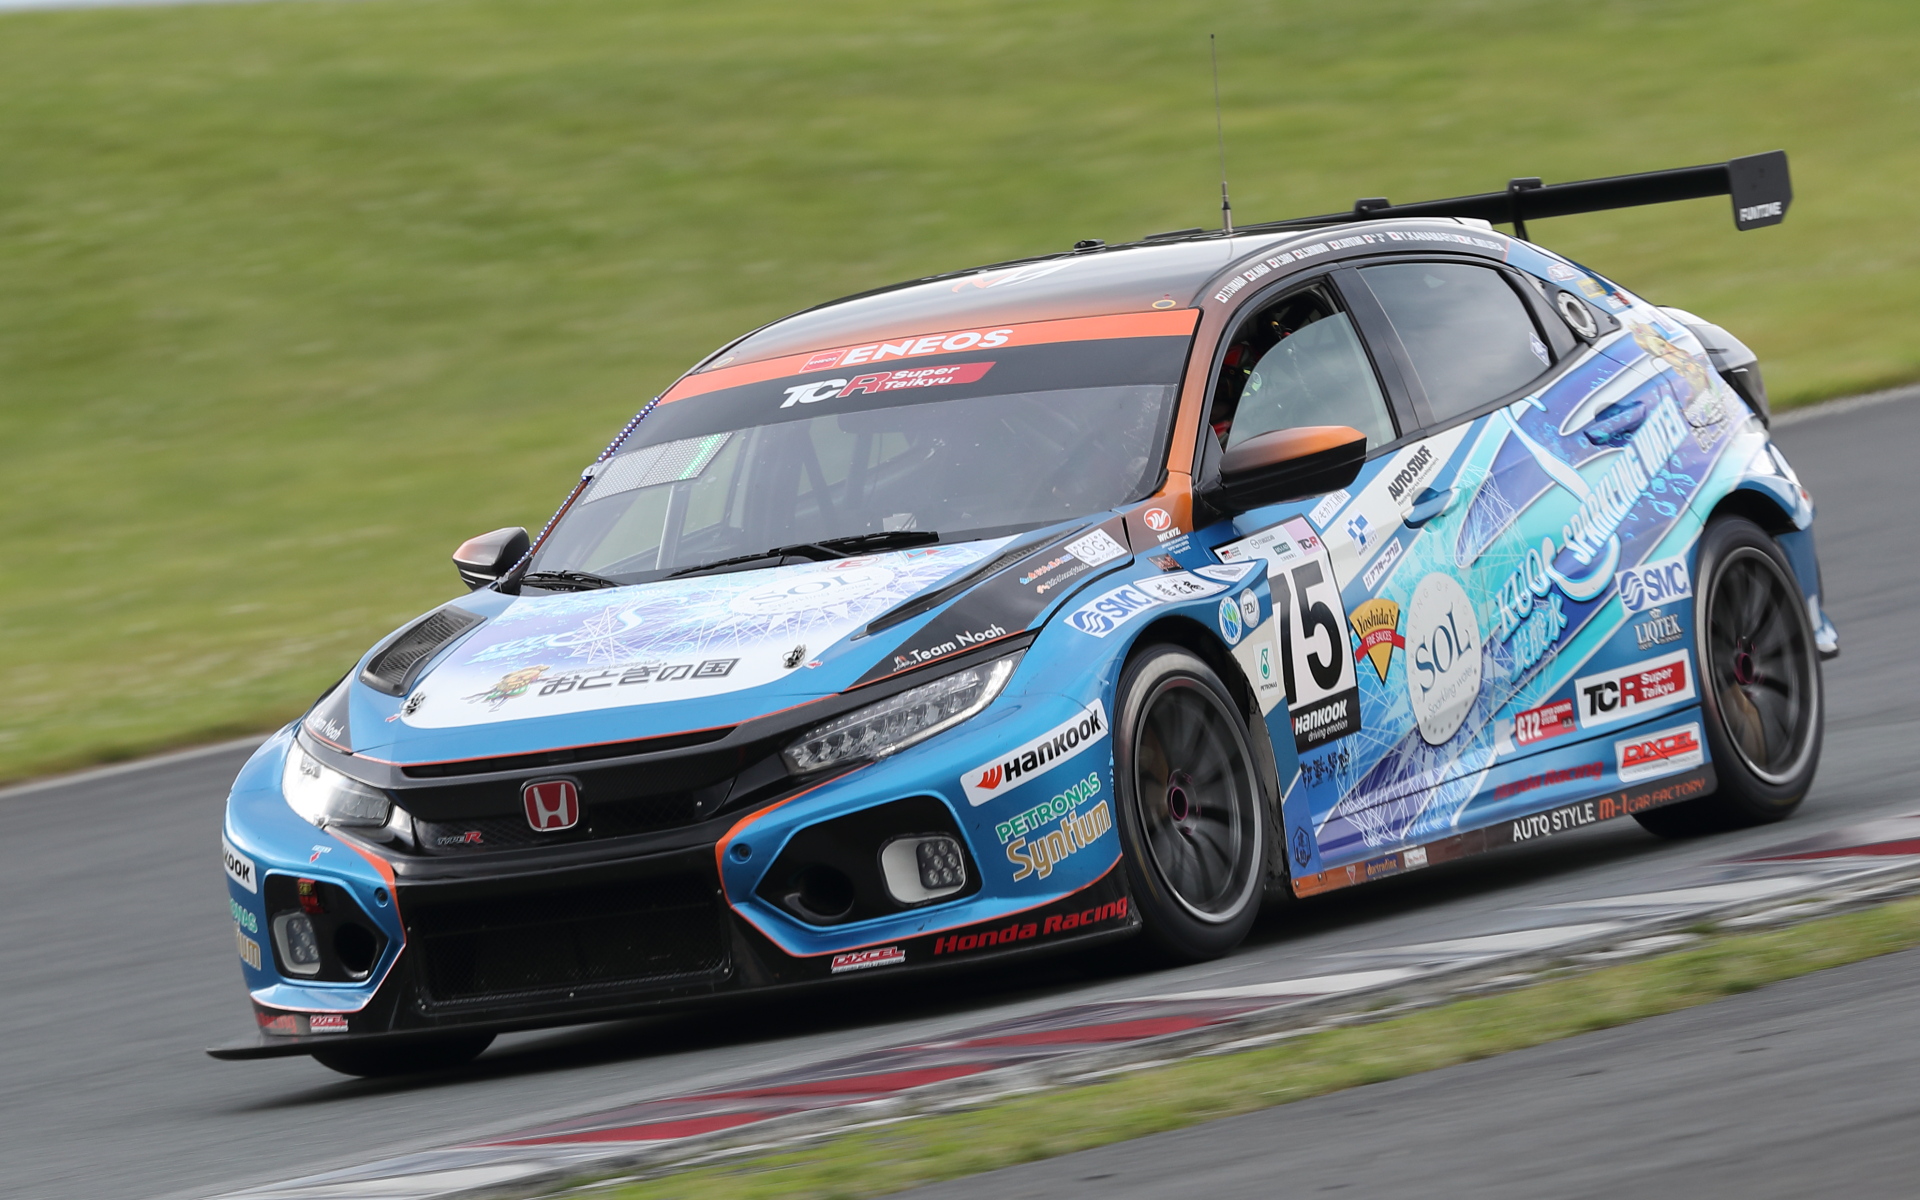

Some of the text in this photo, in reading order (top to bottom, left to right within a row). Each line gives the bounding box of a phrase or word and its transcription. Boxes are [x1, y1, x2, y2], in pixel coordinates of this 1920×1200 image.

[840, 329, 1013, 366] ENEOS
[780, 372, 892, 409] TCR
[884, 375, 953, 391] Taikyu
[892, 366, 960, 380] Super
[1387, 445, 1433, 502] AUTO STAFF
[1563, 395, 1690, 565] SPARKLING WATER
[1075, 535, 1117, 561] KOGA
[1298, 535, 1319, 551] TCR
[750, 573, 872, 607] SOL
[1643, 562, 1689, 600] SMC
[1095, 588, 1153, 619] SMC
[1357, 607, 1395, 634] Yoshida's
[909, 623, 1006, 662] Team Noah
[1269, 559, 1343, 704] 75
[1366, 630, 1392, 648] FINE SAUCES
[1634, 614, 1683, 645] LIQTEK
[1415, 602, 1472, 700] SOL
[537, 657, 741, 698] おとぎの国
[1641, 667, 1673, 685] Super
[1641, 681, 1675, 699] Taikyu
[1583, 677, 1641, 718] TCR
[1307, 720, 1348, 743] driving emotion
[1622, 731, 1699, 768] DIXCEL
[1494, 773, 1542, 801] Honda
[1543, 760, 1604, 788] Racing
[995, 772, 1102, 843] PETRONAS
[1513, 814, 1550, 842] AUTO
[1552, 803, 1596, 831] STYLE
[1629, 795, 1651, 813] CAR
[1652, 777, 1706, 804] FACTORY
[1006, 799, 1112, 883] Syntium
[229, 898, 258, 934] ONAS
[934, 895, 1128, 955] Honda Racing
[831, 945, 905, 970] DIXCEL
